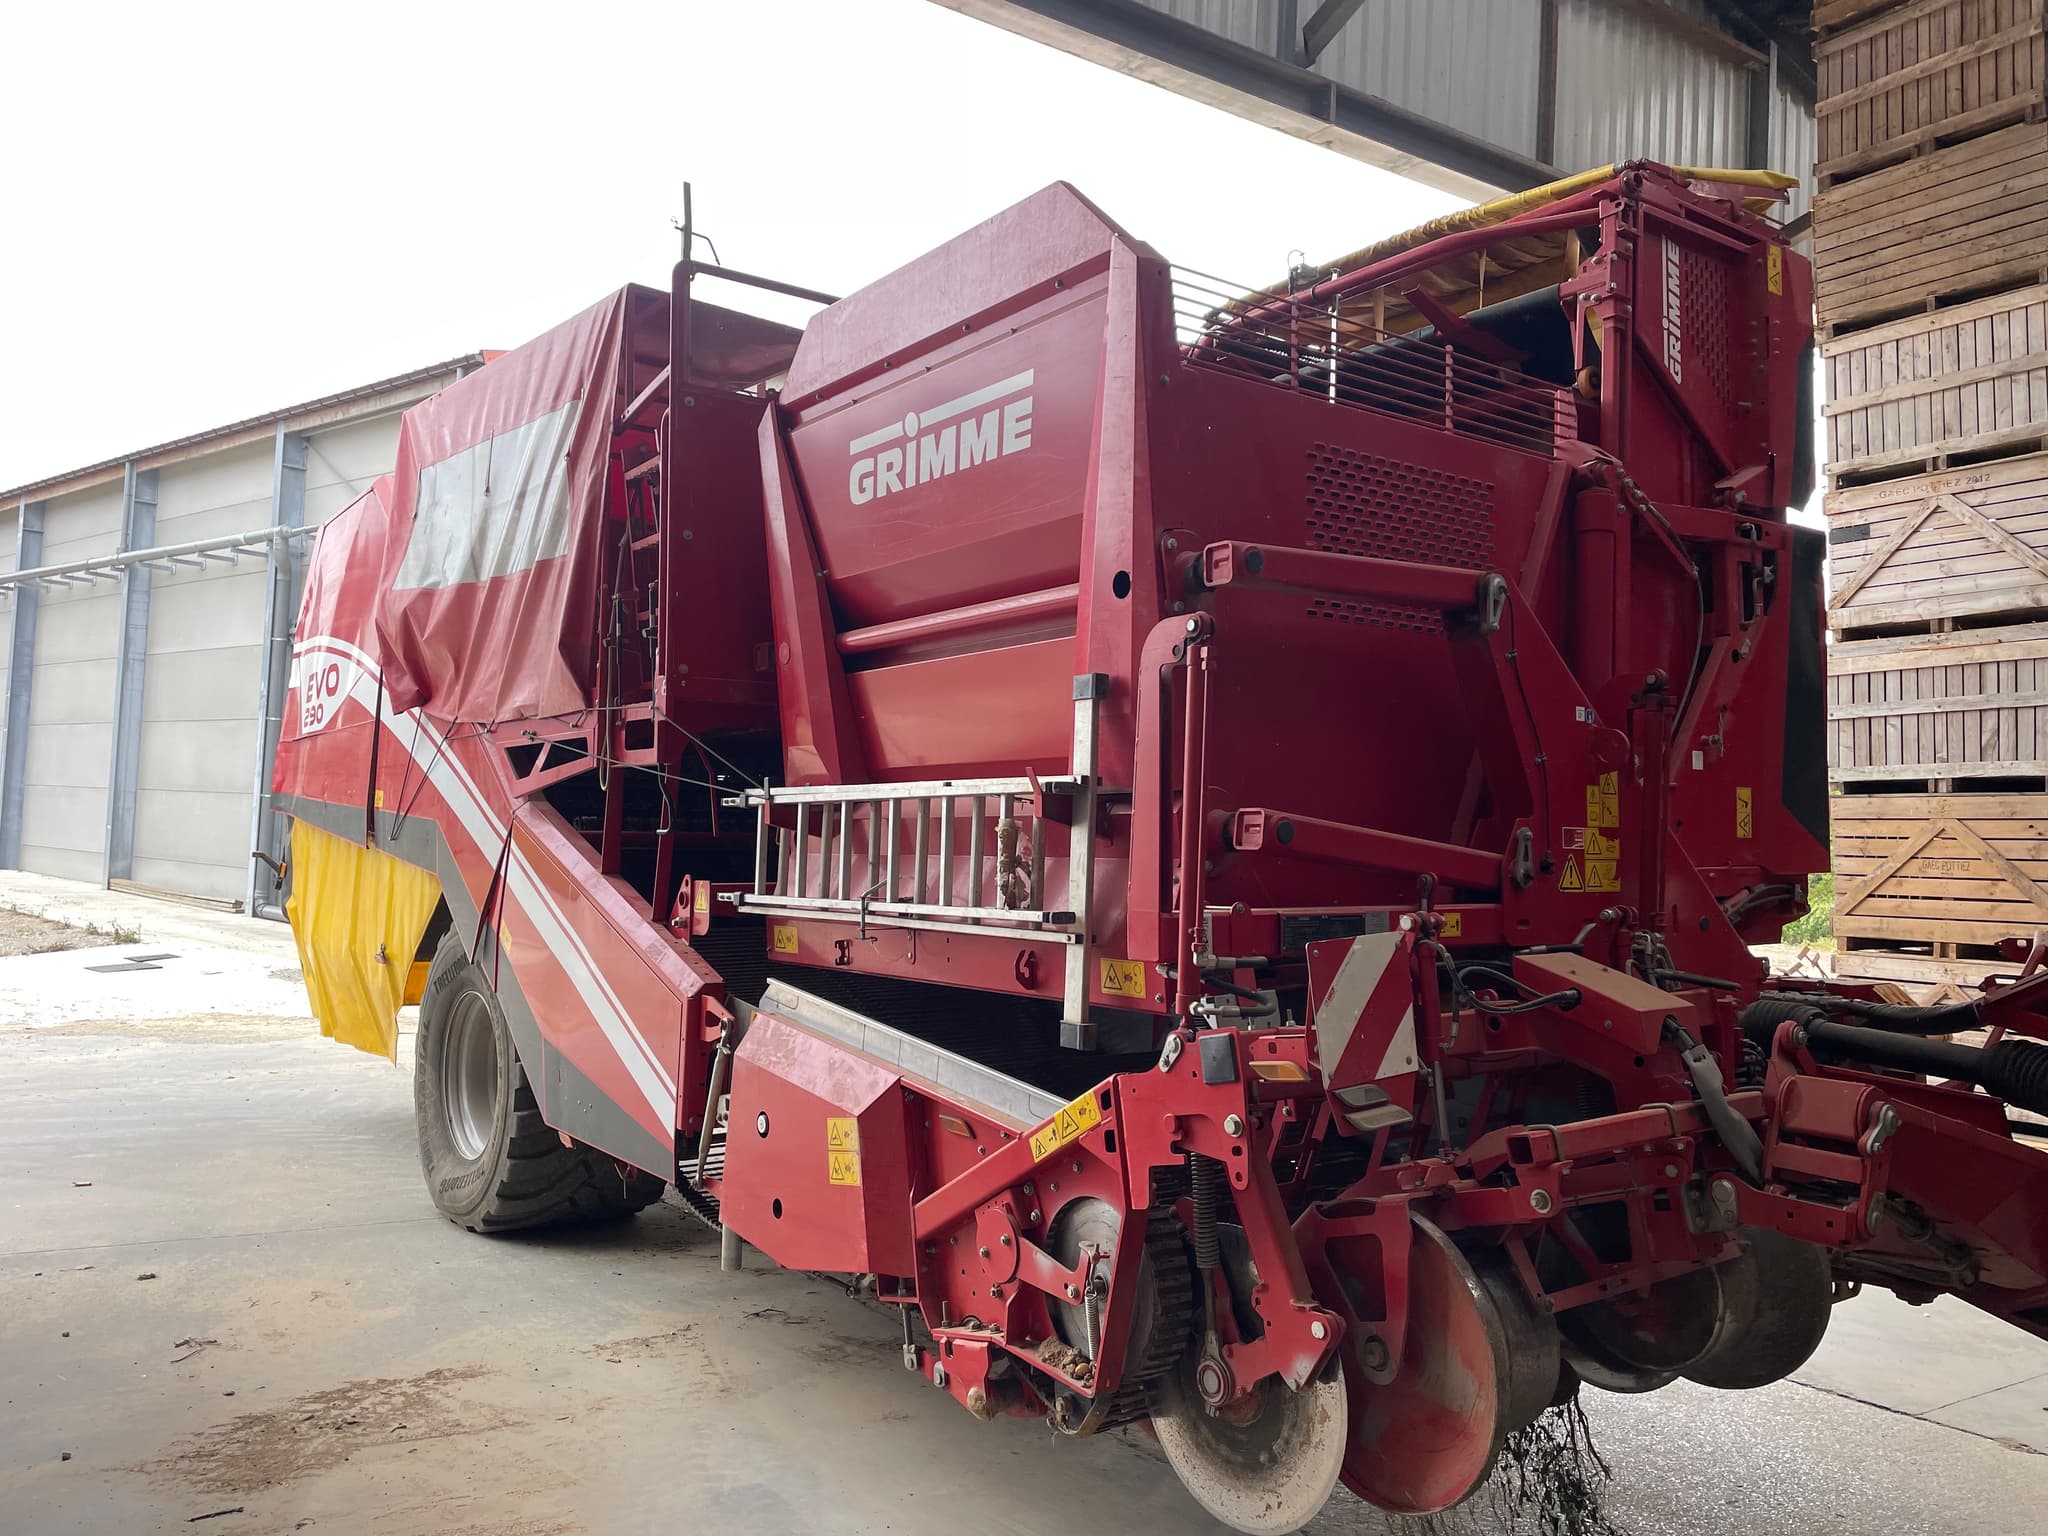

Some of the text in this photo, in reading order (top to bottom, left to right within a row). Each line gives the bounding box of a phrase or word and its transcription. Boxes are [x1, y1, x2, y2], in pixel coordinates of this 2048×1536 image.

[1662, 236, 1682, 384] GRIMME
[849, 390, 1034, 506] GRIMME
[306, 663, 340, 703] EVO
